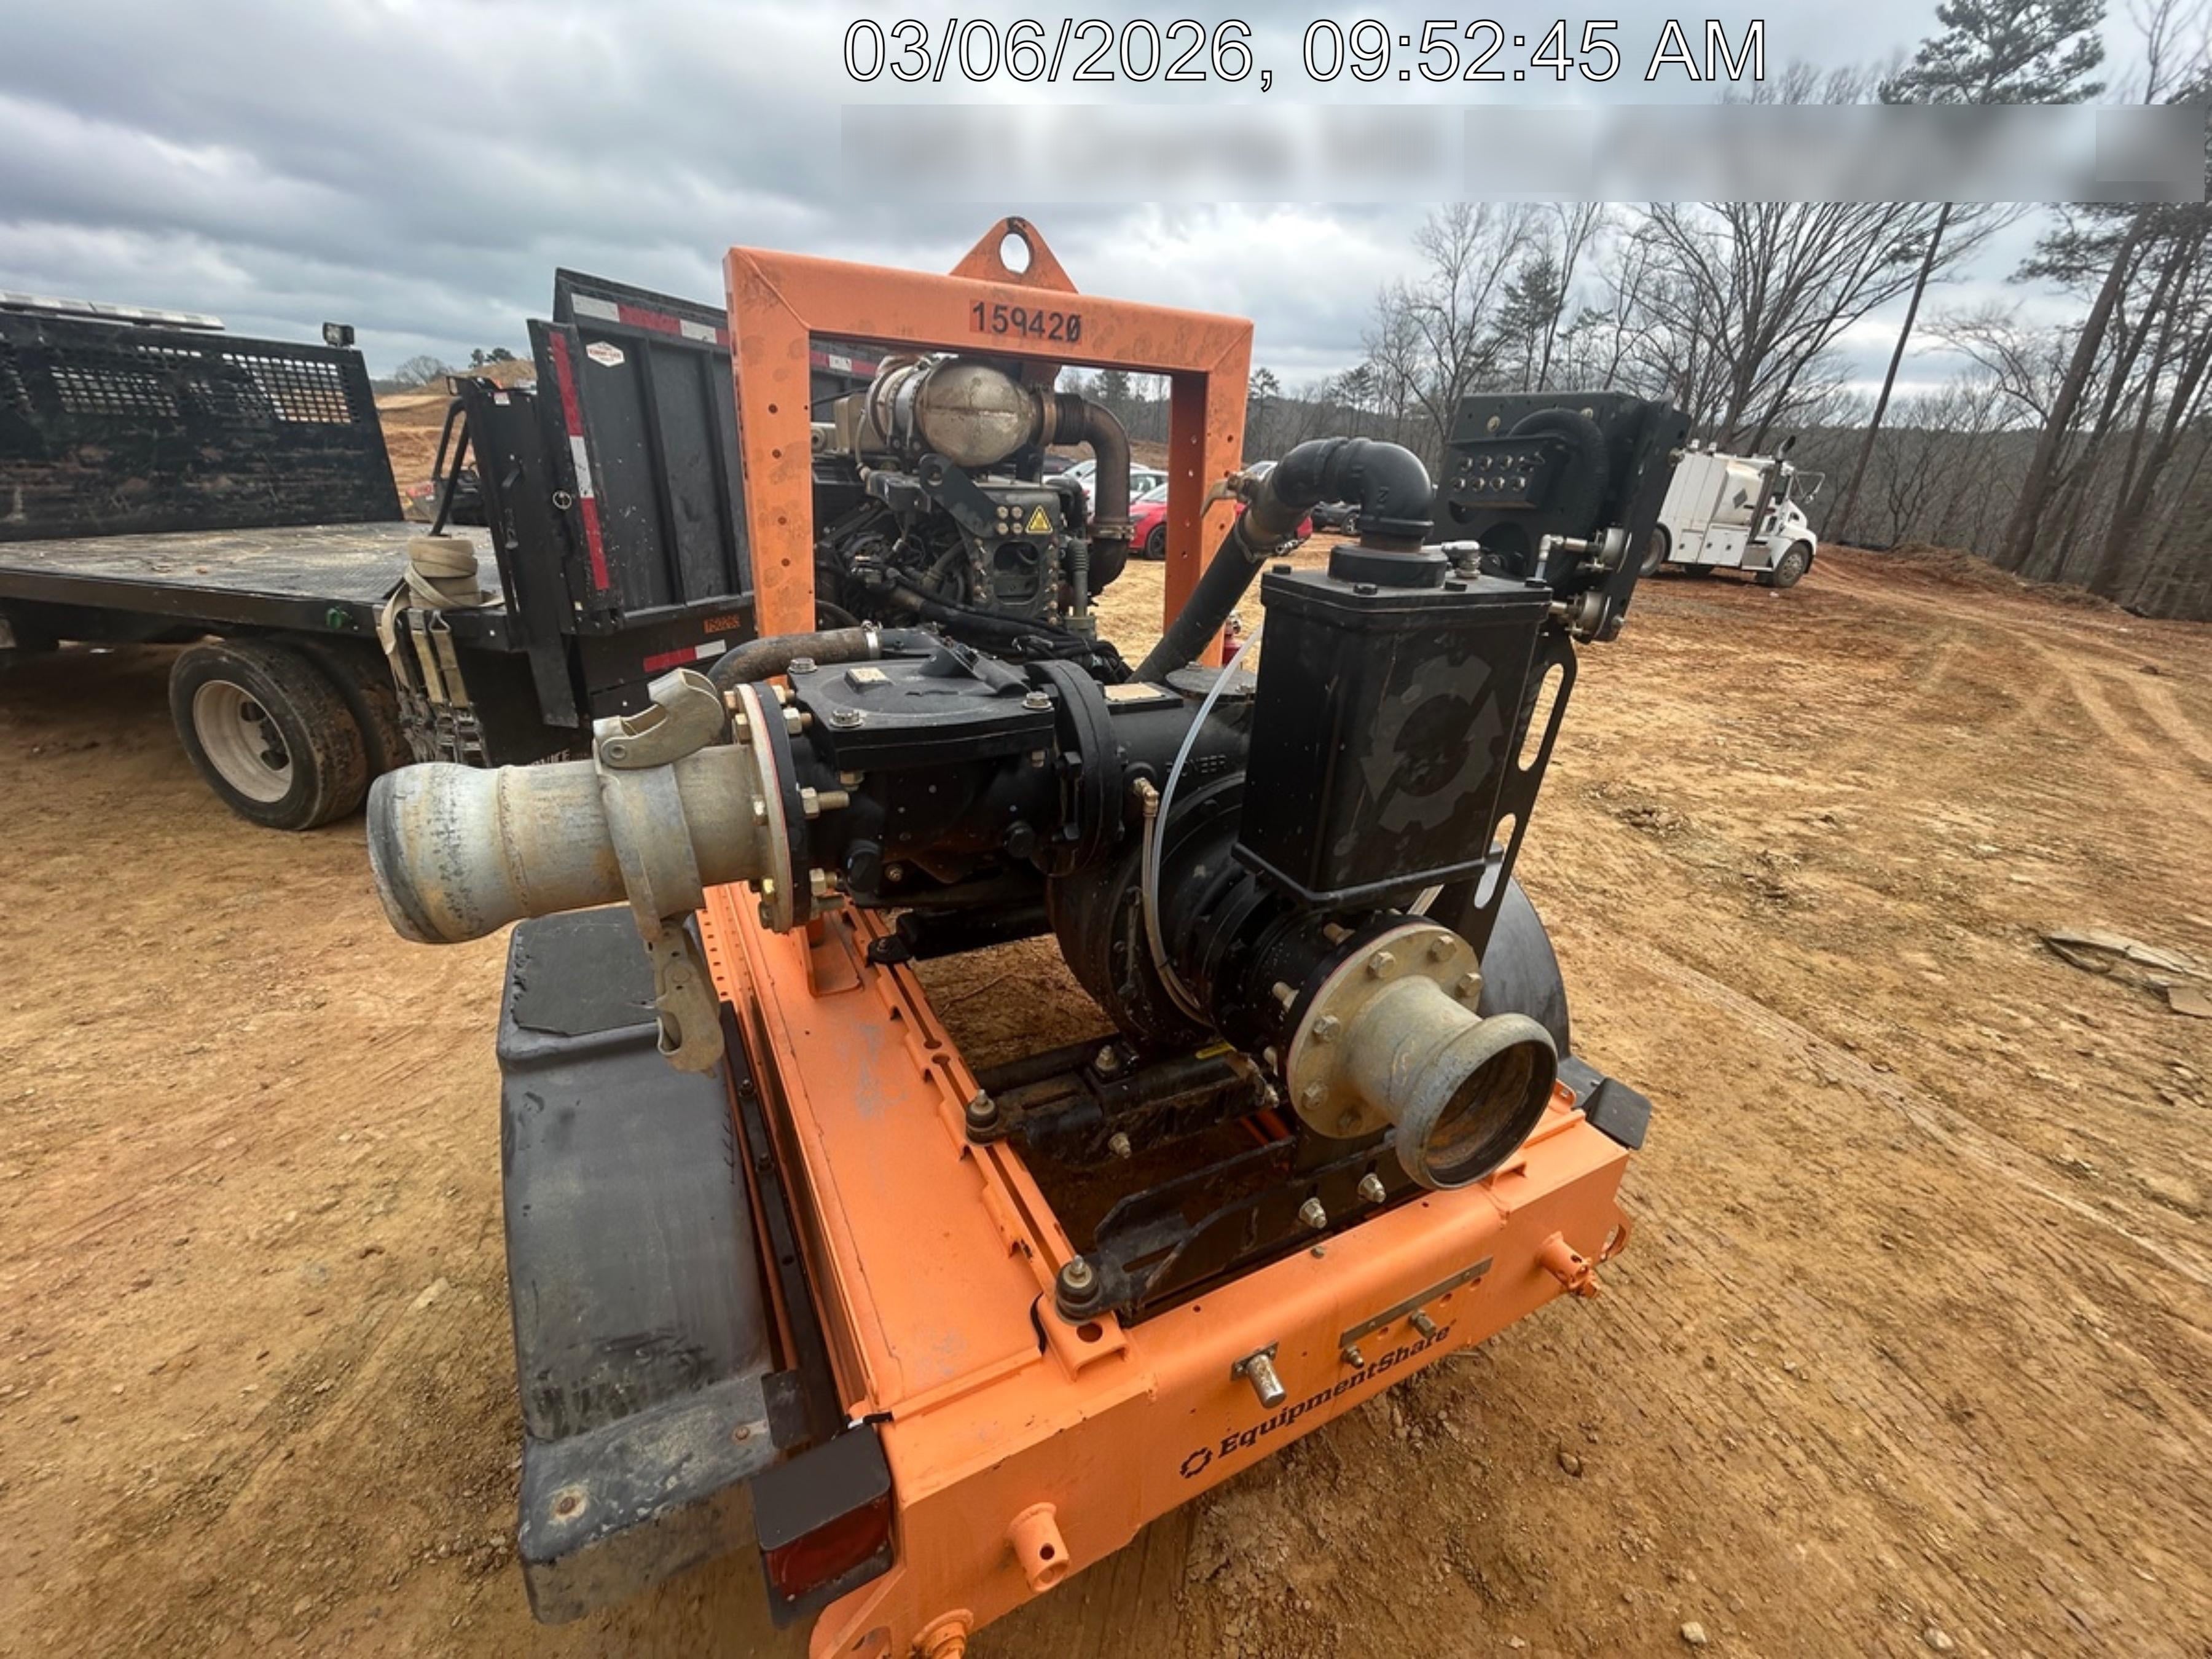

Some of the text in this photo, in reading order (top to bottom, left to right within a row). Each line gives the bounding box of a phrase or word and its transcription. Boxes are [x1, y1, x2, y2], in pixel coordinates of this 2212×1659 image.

[973, 301, 1081, 342] 159420
[1165, 754, 1226, 779] PONEER
[1218, 1326, 1450, 1459] EquipmentShare
